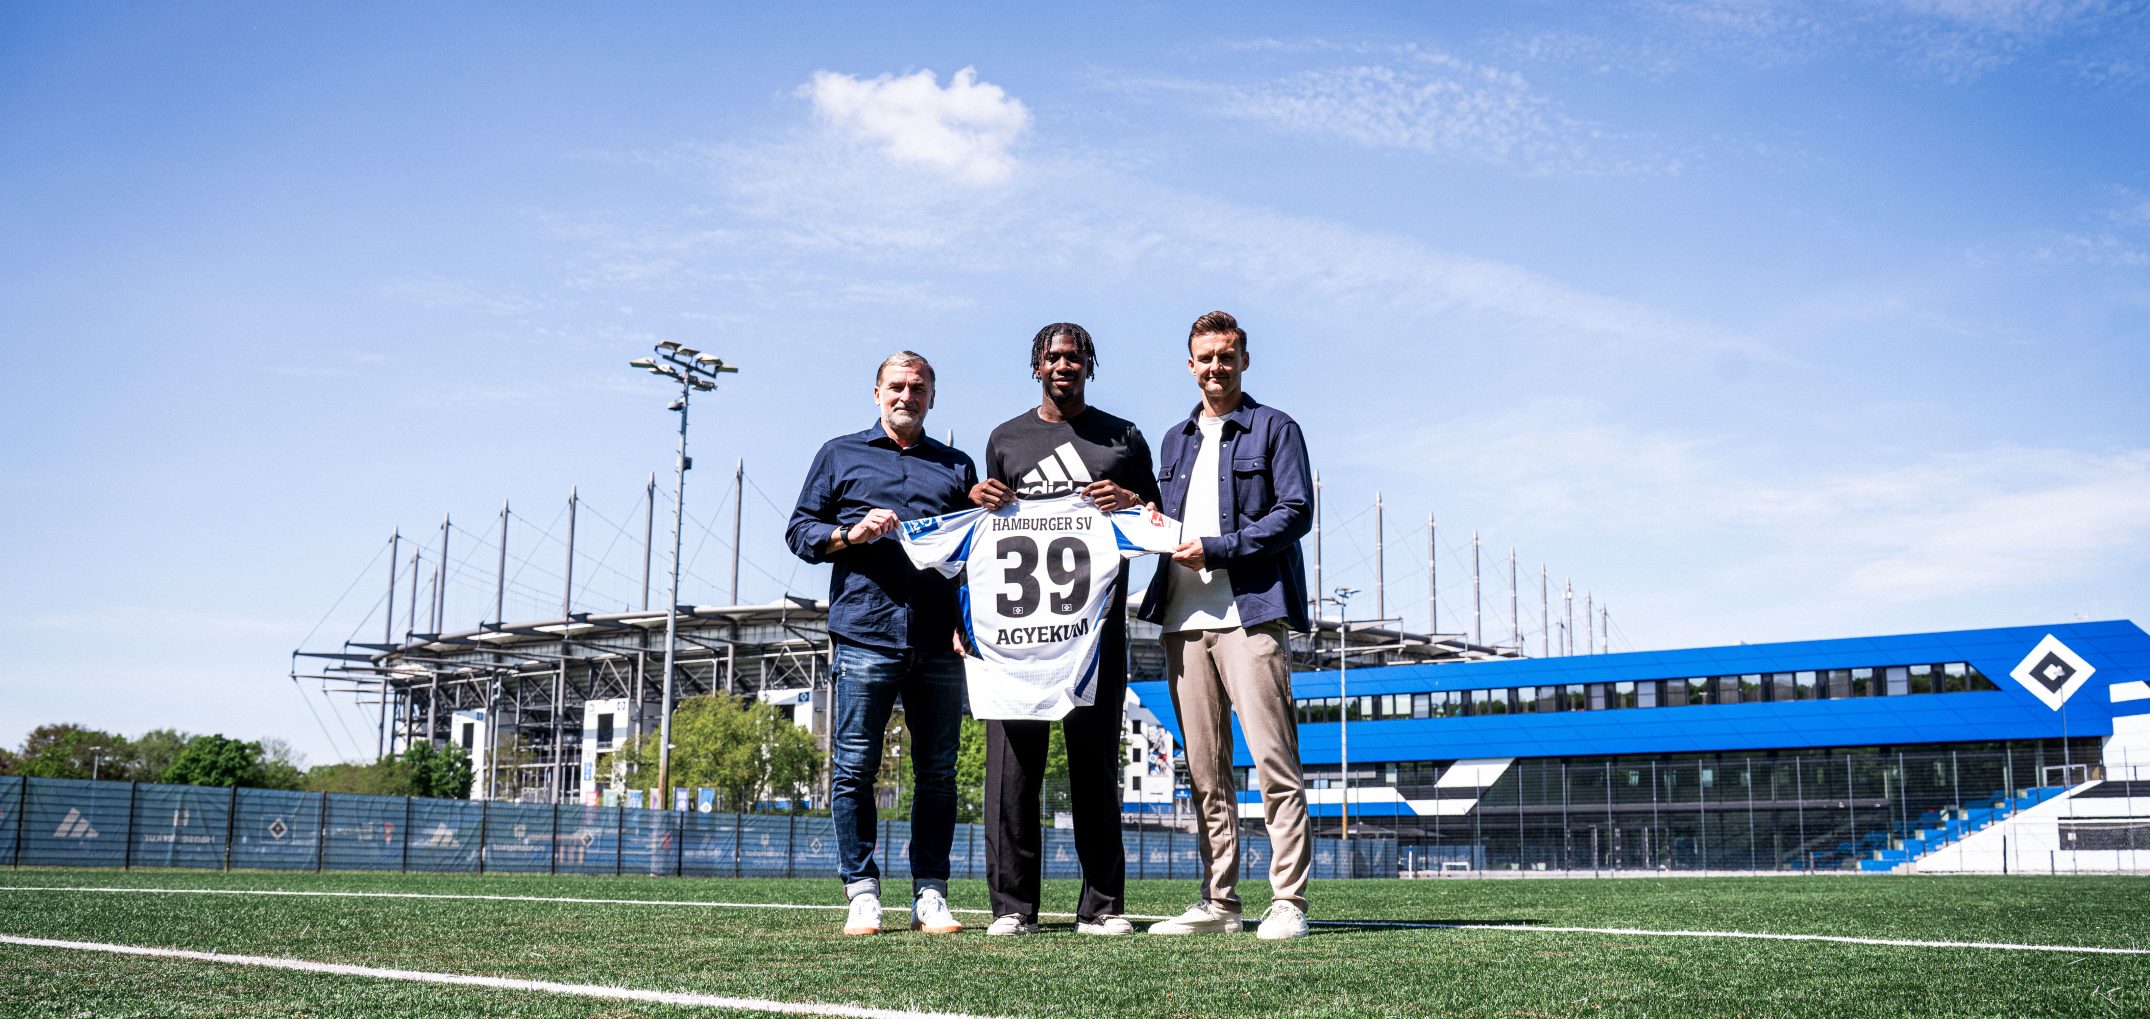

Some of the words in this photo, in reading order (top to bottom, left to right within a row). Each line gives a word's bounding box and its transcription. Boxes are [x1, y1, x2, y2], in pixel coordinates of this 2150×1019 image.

[992, 516, 1073, 531] HAMBURGER
[1076, 516, 1093, 530] SV
[996, 535, 1092, 618] 39
[995, 617, 1089, 645] AGYEKUM
